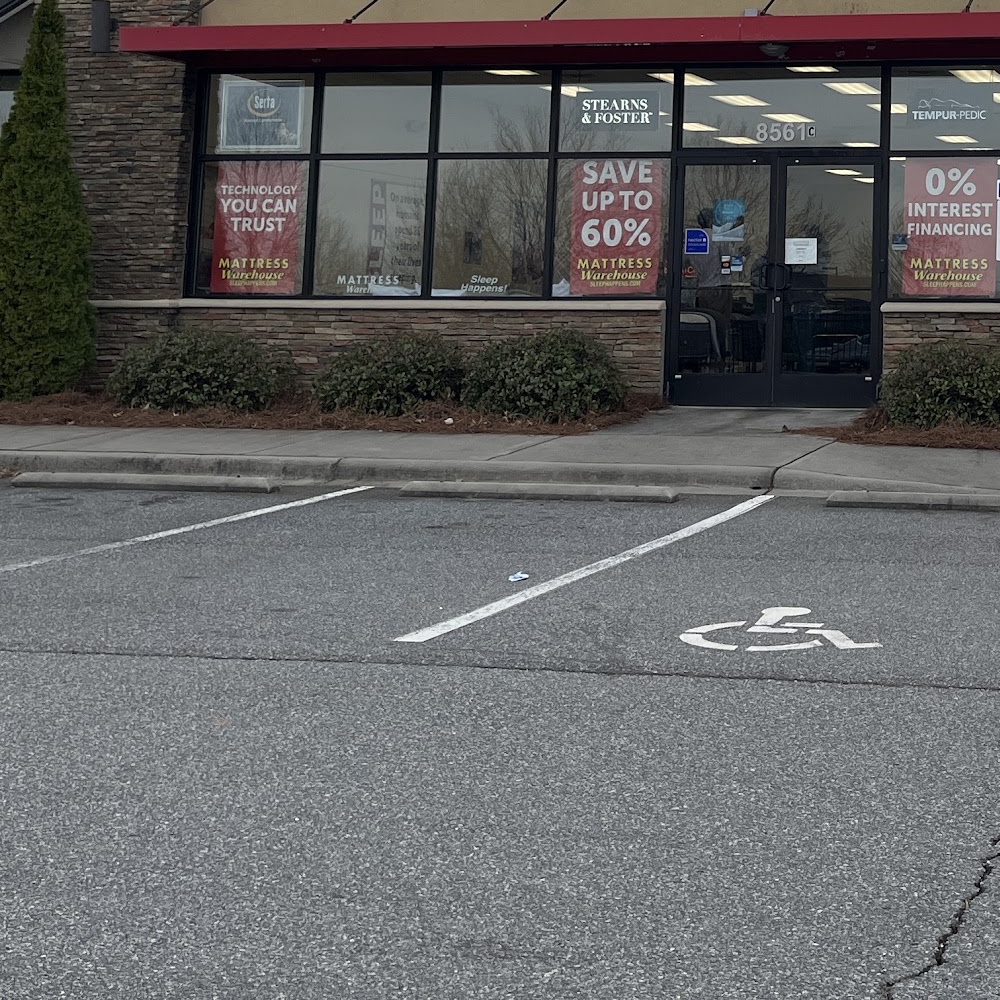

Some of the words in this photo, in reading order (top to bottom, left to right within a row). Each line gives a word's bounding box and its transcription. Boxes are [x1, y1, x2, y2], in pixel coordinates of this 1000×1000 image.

[254, 96, 275, 109] Serta
[582, 99, 648, 111] STEARNS
[581, 112, 592, 124] &
[594, 112, 650, 124] FOSTER
[912, 110, 987, 120] TEMPUR-PEDIC
[756, 122, 806, 142] 8561
[582, 160, 653, 185] SAVE
[925, 168, 977, 196] 0%
[221, 185, 298, 195] TECHNOLOGY
[221, 198, 258, 213] YOU
[262, 198, 297, 213] CAN
[582, 191, 615, 211] UP
[619, 190, 653, 210] TO
[908, 202, 993, 217] INTEREST
[230, 217, 286, 232] TRUST
[907, 223, 993, 236] FINANCING
[581, 218, 651, 247] 60%
[218, 258, 289, 269] MATTRESS
[577, 257, 653, 270] MATTRESS
[910, 258, 988, 270] MATTRESS
[221, 269, 285, 280] Warehouse
[336, 275, 400, 285] MATTRESS
[470, 275, 499, 285] Sleep
[580, 269, 648, 280] Warehouse
[914, 270, 983, 281] Warehouse
[460, 283, 508, 293] Happens!
